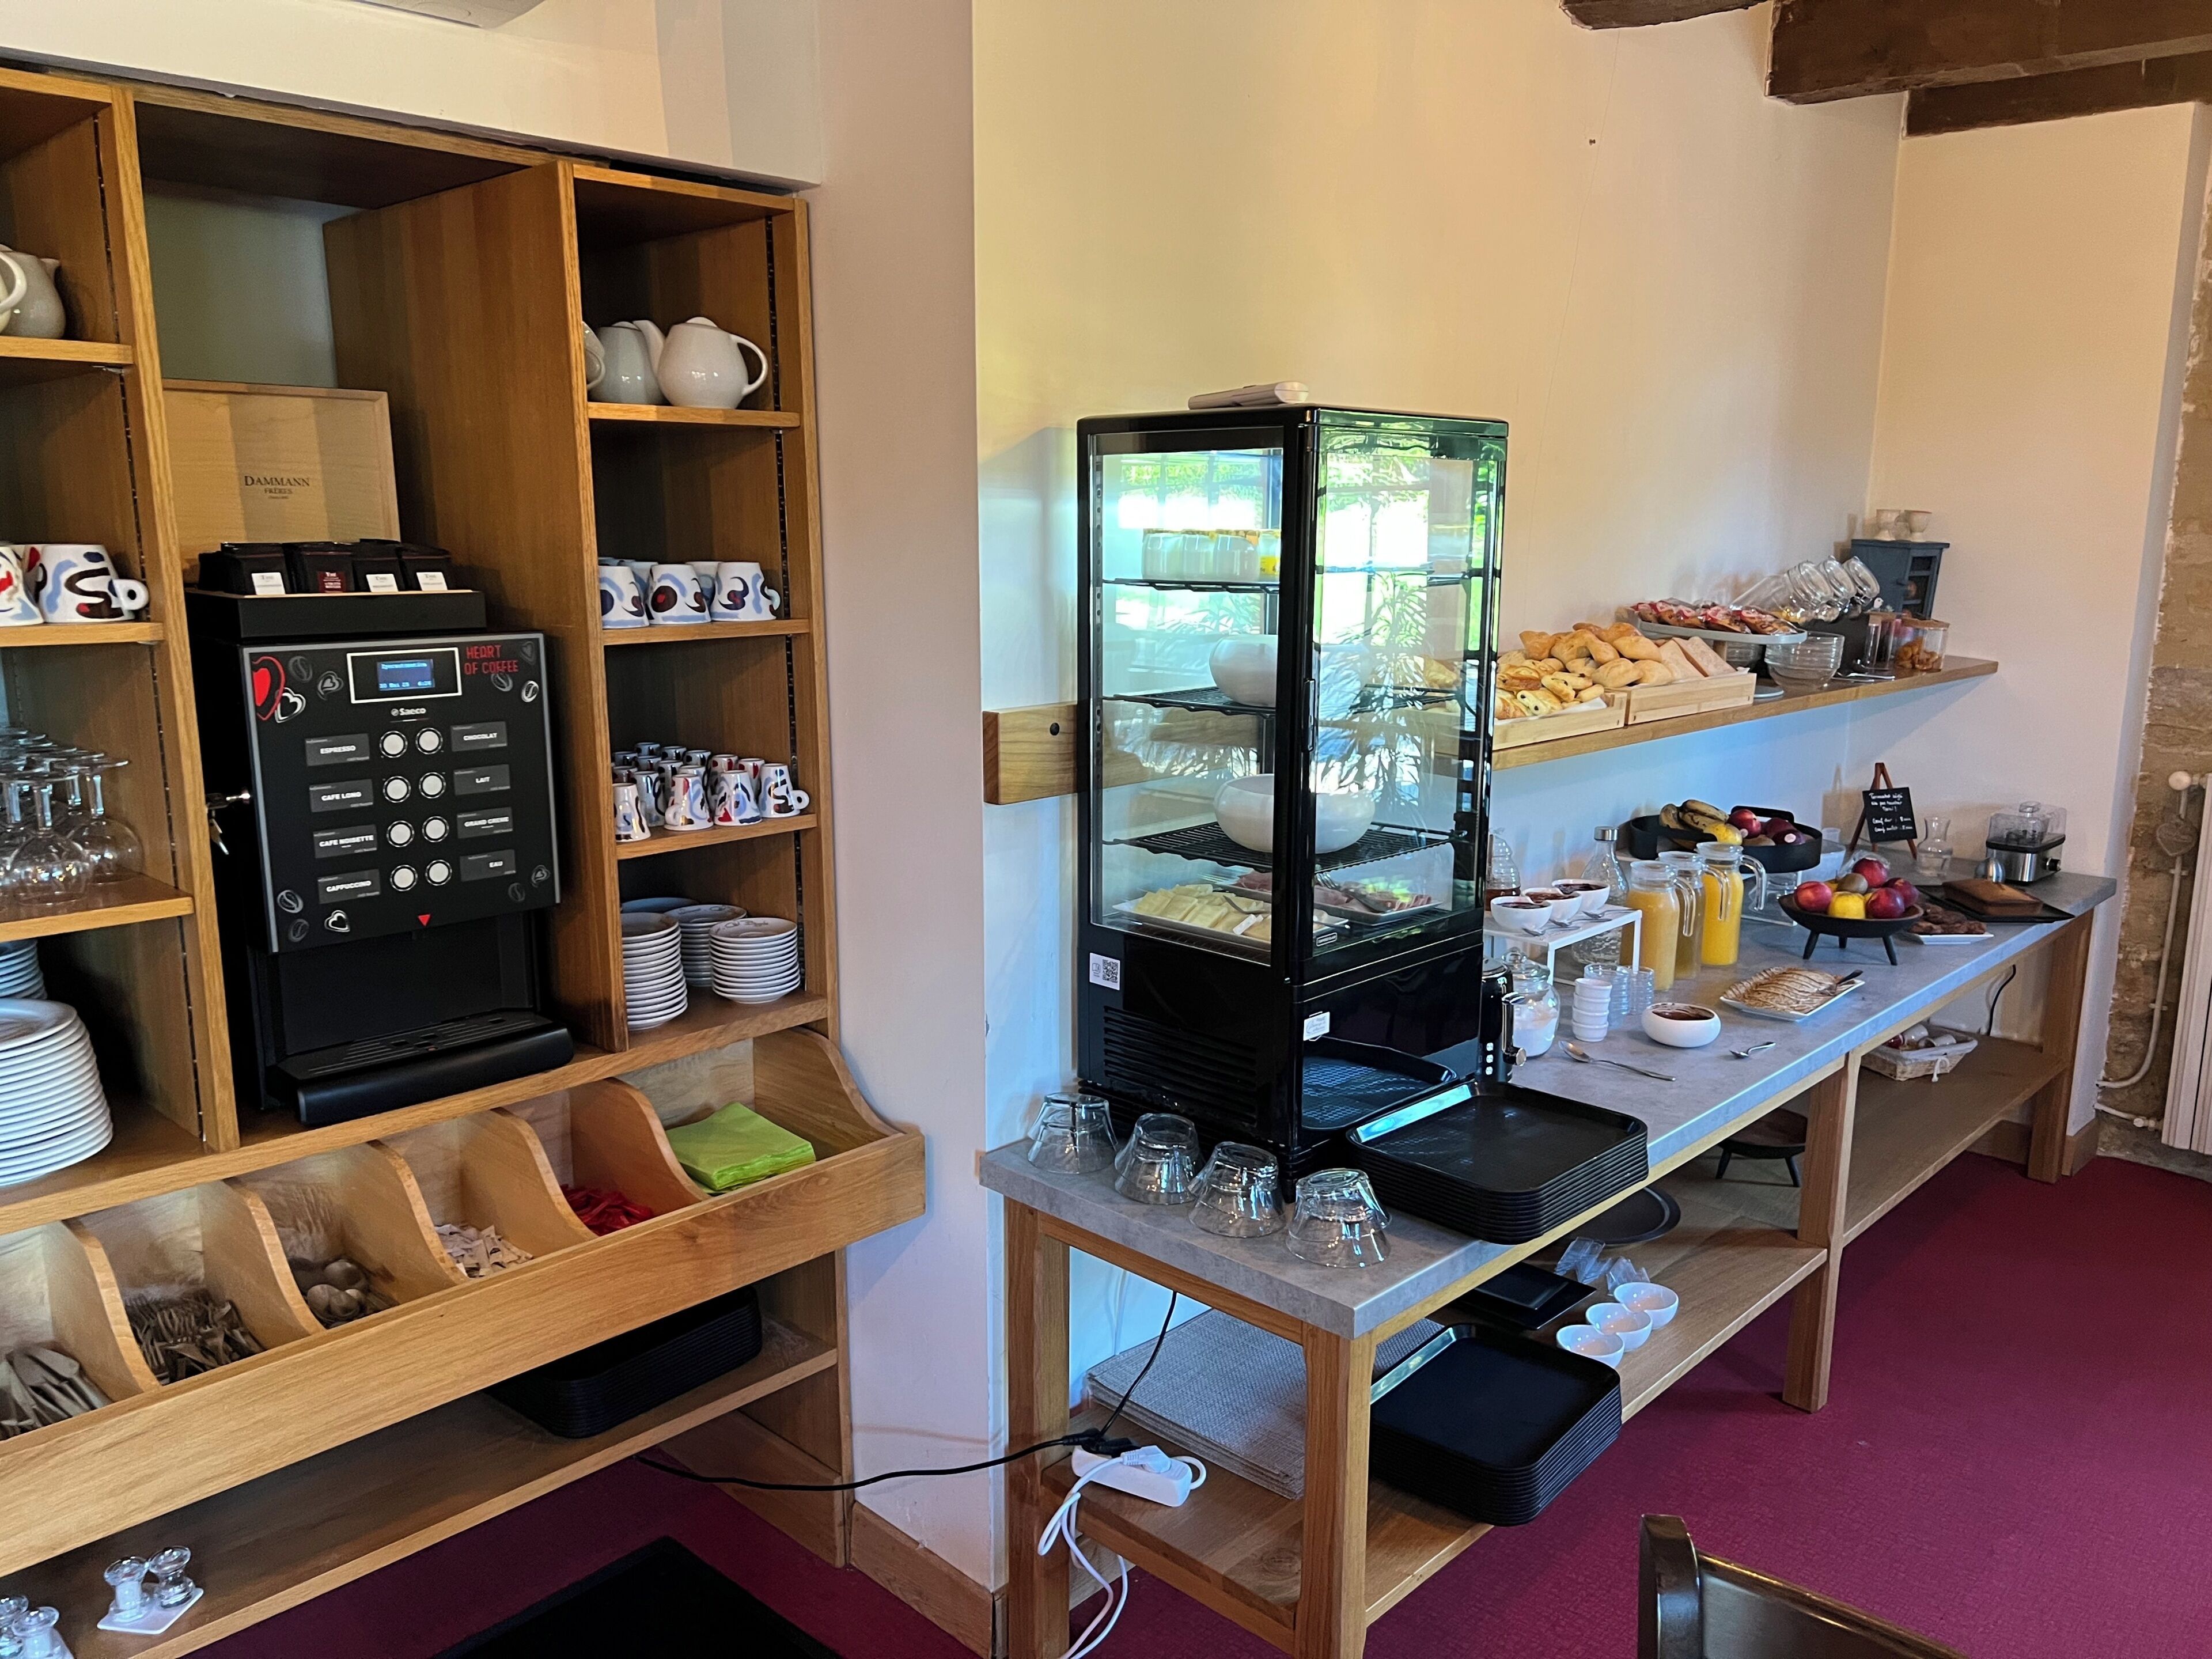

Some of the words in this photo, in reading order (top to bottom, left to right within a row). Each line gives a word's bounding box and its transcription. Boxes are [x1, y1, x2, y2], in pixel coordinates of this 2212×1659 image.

[244, 475, 309, 487] DAMMANN
[466, 645, 501, 659] HEART
[464, 662, 478, 675] OF
[482, 660, 518, 675] COFFEE
[399, 707, 426, 715] Saeco
[463, 732, 498, 741] CHOCOLAT
[320, 745, 357, 754] ESPRESSO
[341, 791, 362, 799] LONG
[464, 819, 487, 827] GRAND
[339, 835, 374, 844] NOISETTE
[326, 880, 372, 892] CAPPUCCINO
